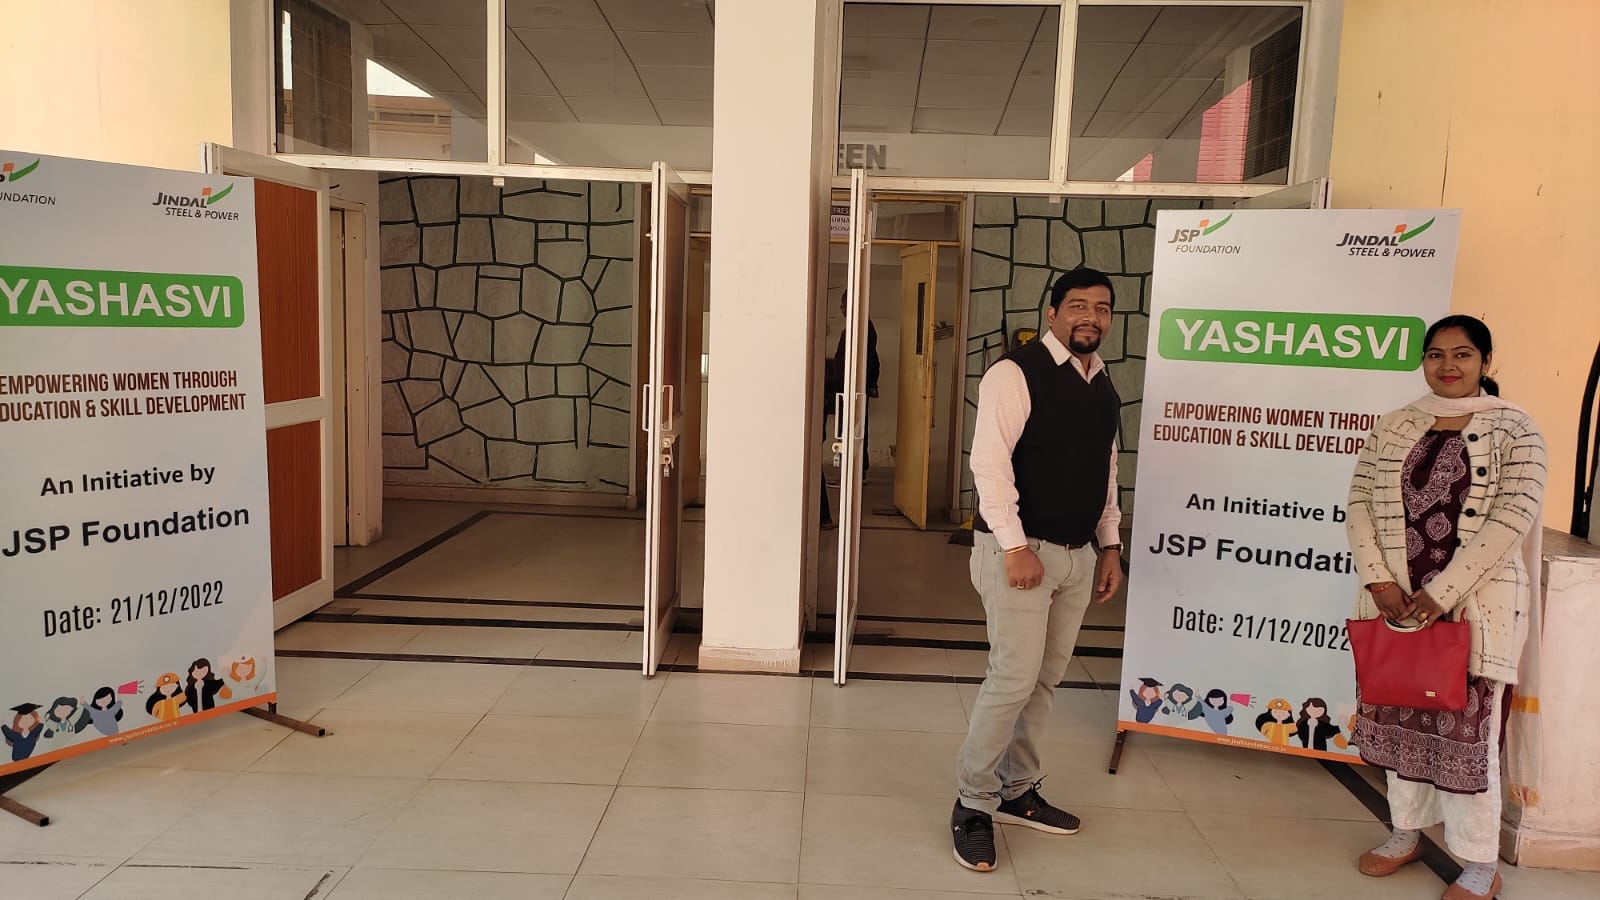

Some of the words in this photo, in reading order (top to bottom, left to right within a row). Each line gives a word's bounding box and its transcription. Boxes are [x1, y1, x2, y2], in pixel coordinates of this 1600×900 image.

[152, 192, 208, 208] JINDAL
[165, 207, 192, 218] STEEL
[194, 209, 202, 218] &
[204, 210, 239, 221] POWER
[1168, 229, 1201, 244] JSP
[1175, 244, 1241, 254] FOUNDATION
[1336, 232, 1399, 247] JINDAL
[1348, 246, 1380, 257] STEEL
[1382, 248, 1390, 257] &
[1393, 248, 1436, 258] POWER
[0, 278, 231, 318] YASHASVI
[1175, 318, 1410, 361] YASHASVI
[0, 373, 109, 395] EMPOWERING
[113, 371, 170, 391] WOMEN
[173, 370, 237, 390] THROUGH
[86, 400, 96, 418] &
[100, 397, 142, 416] SKILL
[146, 393, 246, 415] DEVELOPMENT
[1164, 402, 1262, 424] EMPOWERING
[1266, 407, 1324, 428] WOMEN
[1153, 424, 1232, 446] EDUCATION
[1236, 430, 1245, 446] &
[1250, 430, 1291, 450] SKILL
[40, 478, 74, 496] An
[82, 466, 183, 492] Initiative
[190, 464, 216, 485] by
[1186, 493, 1215, 512] An
[1223, 496, 1324, 522] Initiative
[1, 524, 70, 557] JSP
[82, 508, 250, 546] Foundation
[1149, 532, 1207, 558] JSP
[1216, 538, 1358, 574] Foundati
[44, 606, 102, 638] Date:
[111, 580, 224, 624] 21/12/2022
[1172, 606, 1224, 634] Date:
[1232, 614, 1350, 652] 21/12/2022
